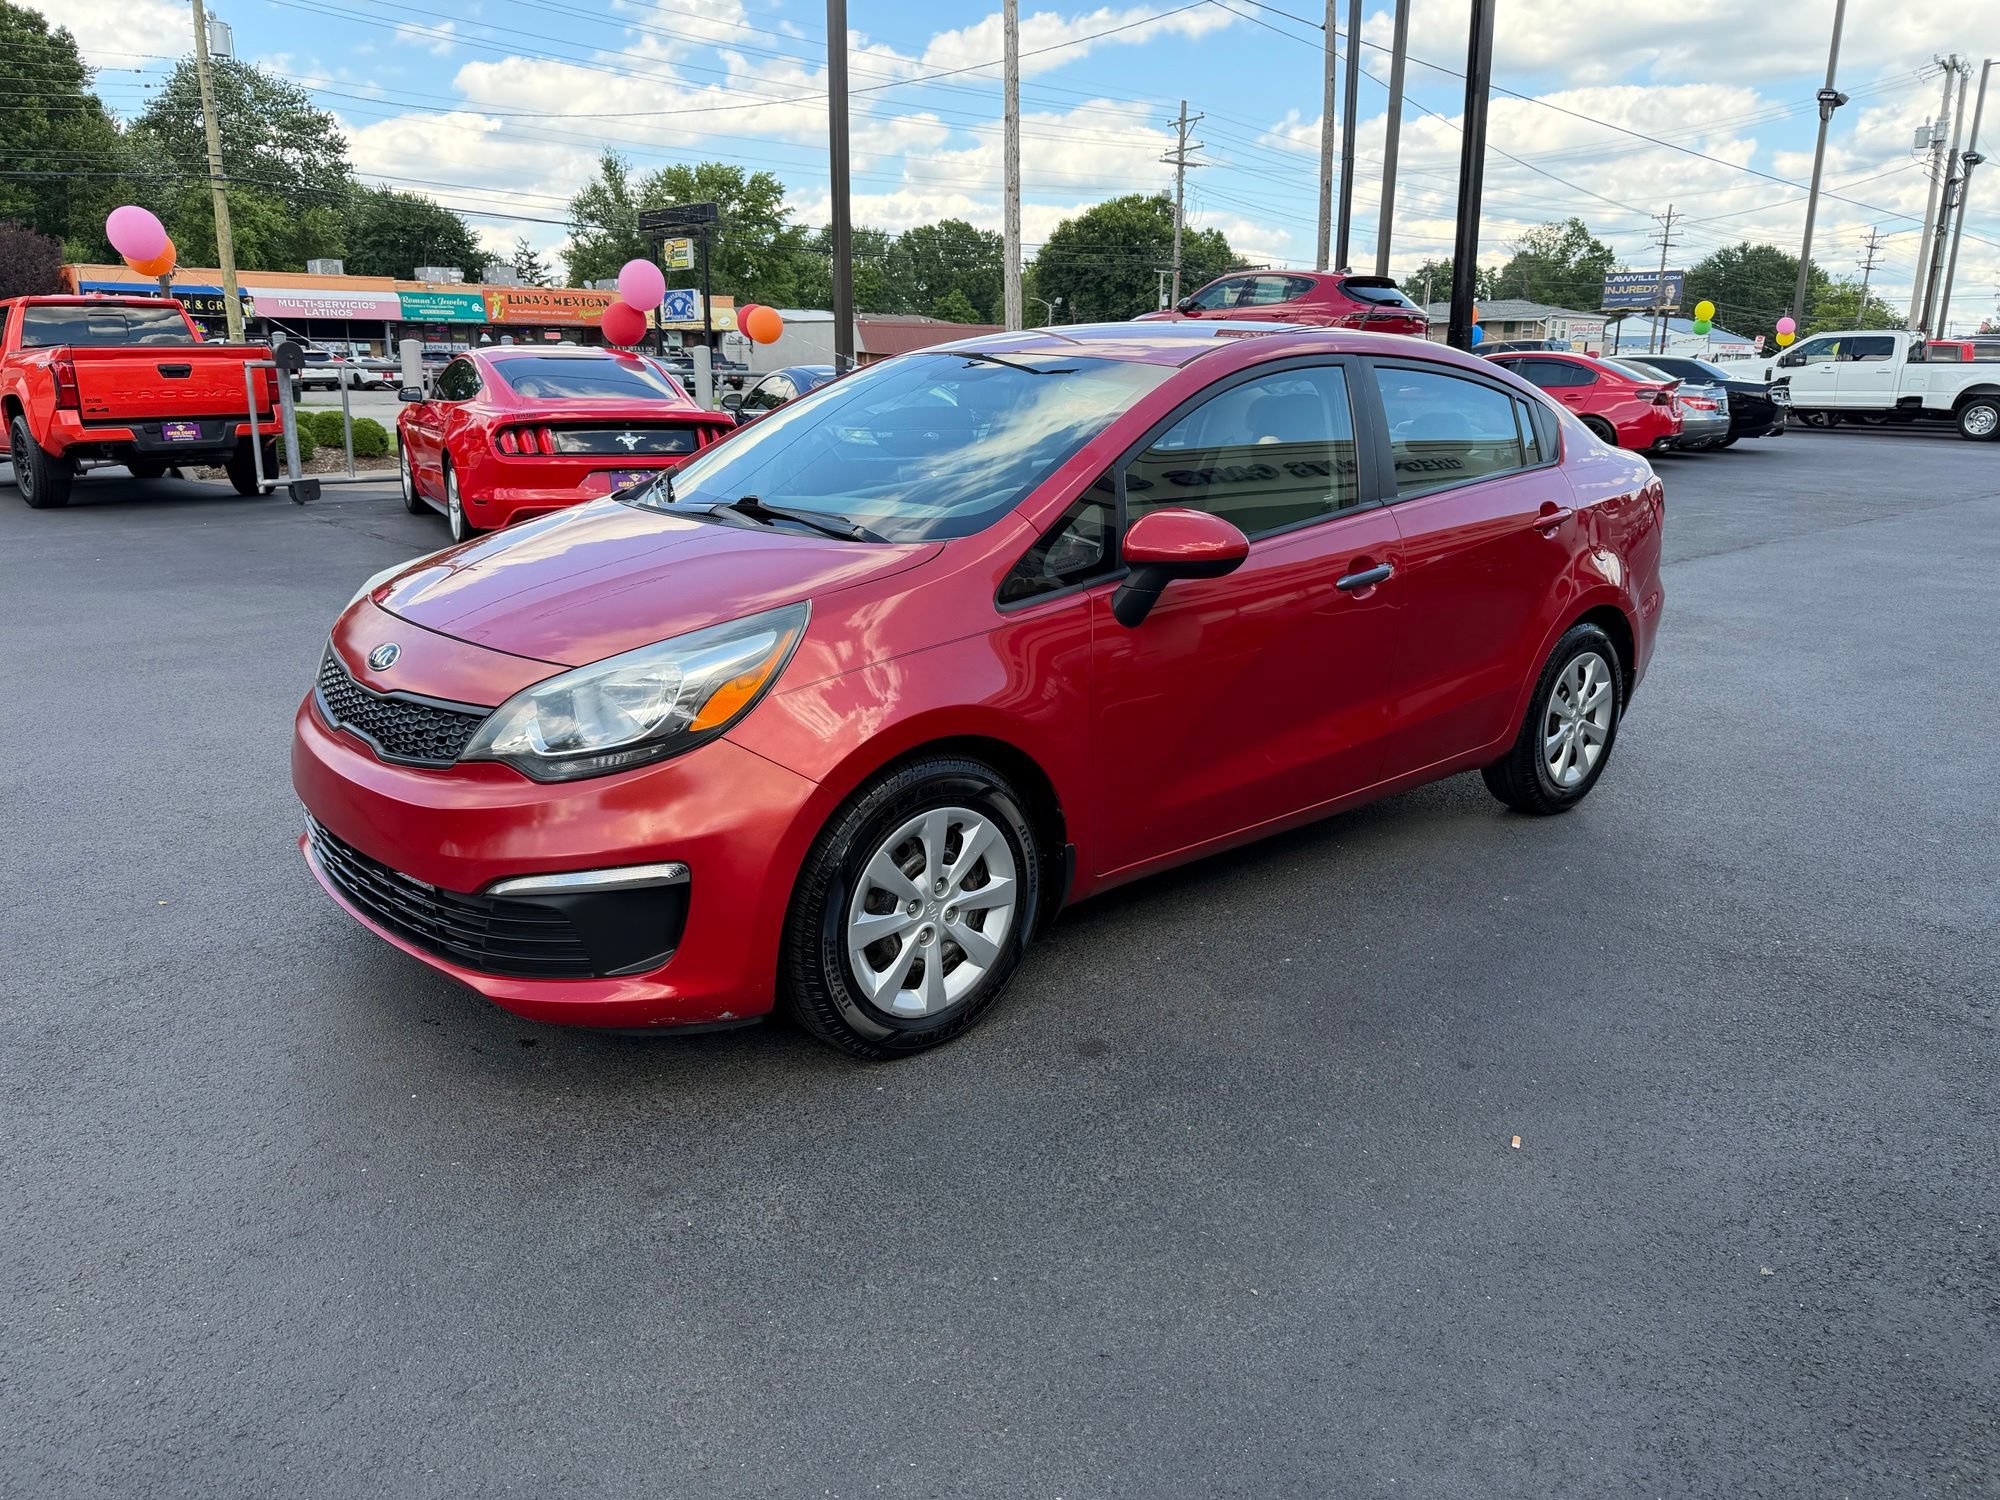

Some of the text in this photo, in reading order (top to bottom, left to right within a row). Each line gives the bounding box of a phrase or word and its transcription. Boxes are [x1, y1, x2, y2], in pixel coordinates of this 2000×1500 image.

[1604, 285, 1659, 295] INJURED?
[195, 299, 204, 310] &
[278, 299, 377, 310] MULTI-SERVICIOS
[507, 294, 609, 308] LUNA'S MEXICAN
[304, 308, 353, 317] LATINOS
[112, 388, 244, 400] TACOMA
